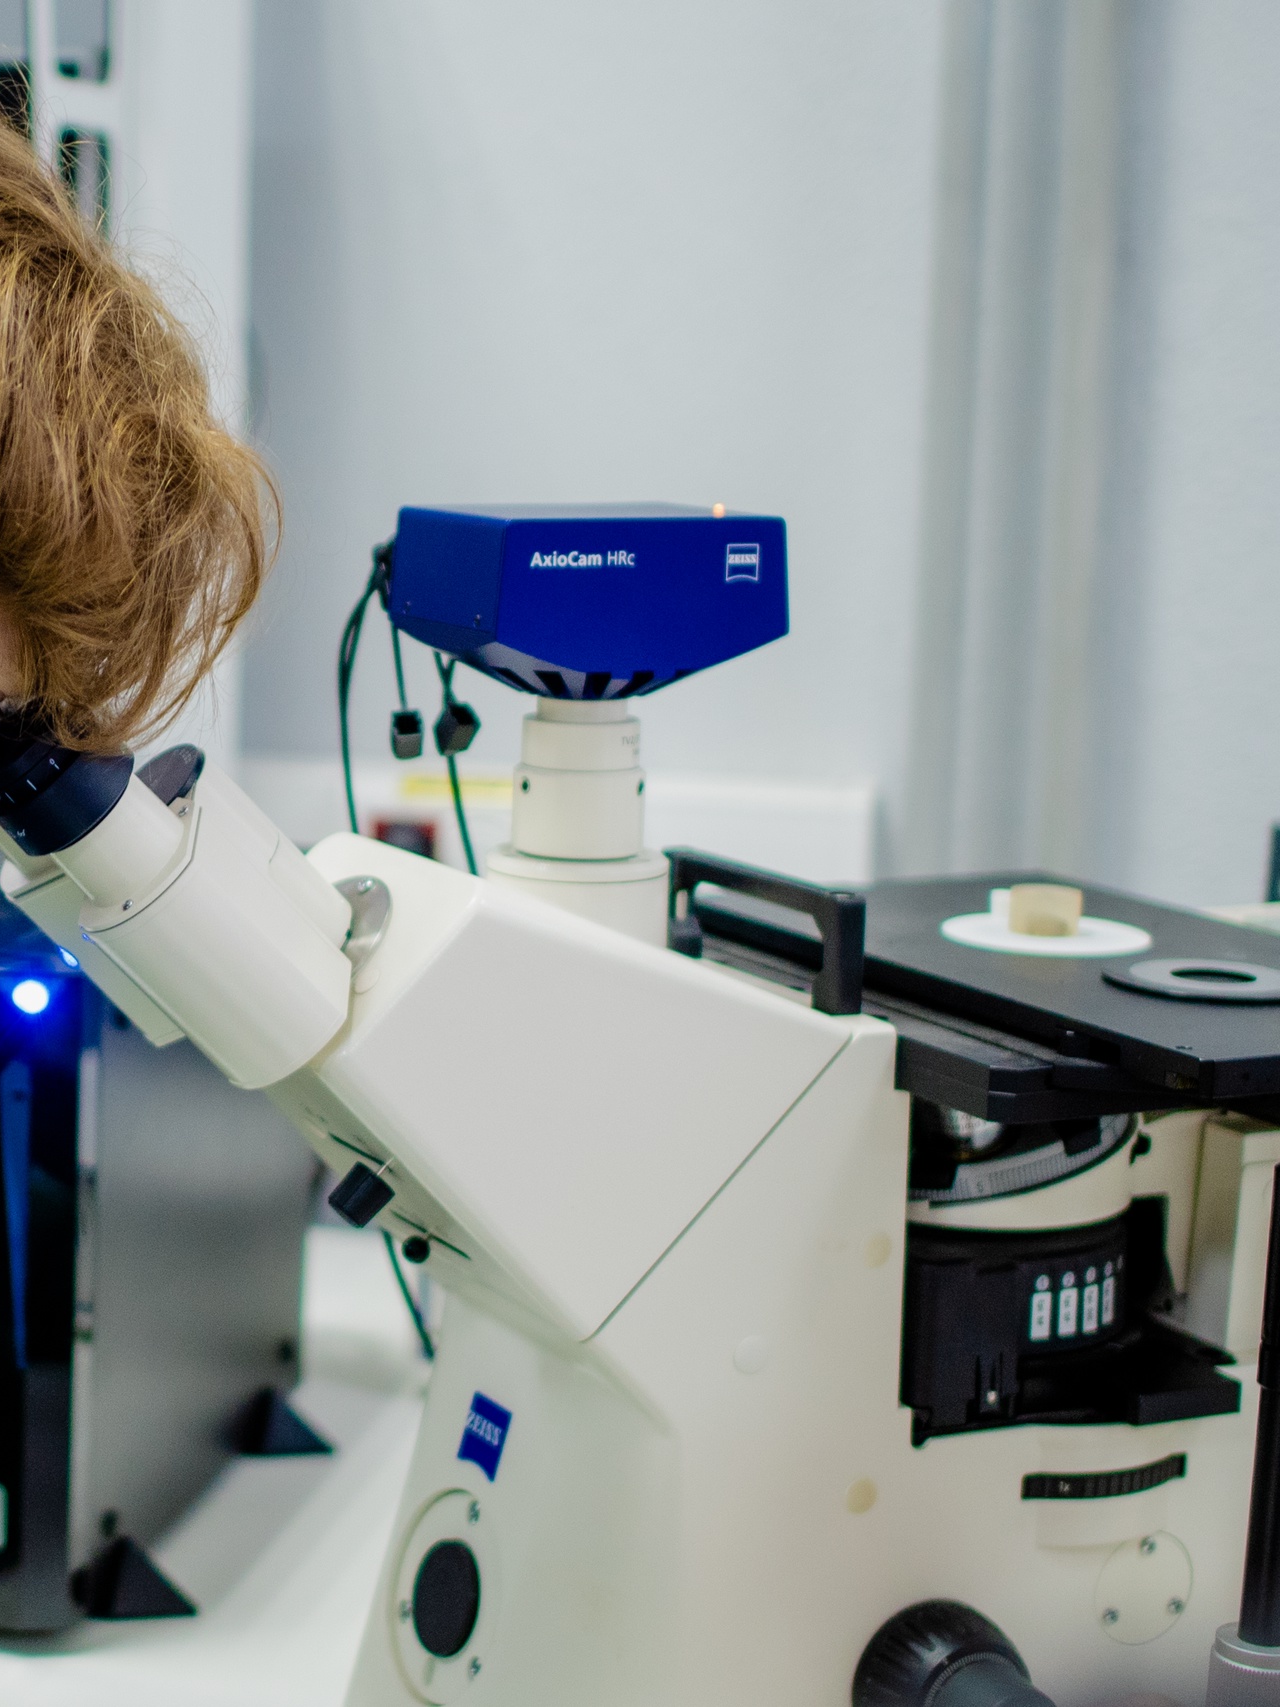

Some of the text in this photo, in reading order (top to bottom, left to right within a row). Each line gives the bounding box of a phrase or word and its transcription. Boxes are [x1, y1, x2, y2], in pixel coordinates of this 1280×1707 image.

[530, 549, 636, 568] AxioCam HRc
[728, 553, 758, 565] ZEISS
[467, 1411, 502, 1447] ZEISS
